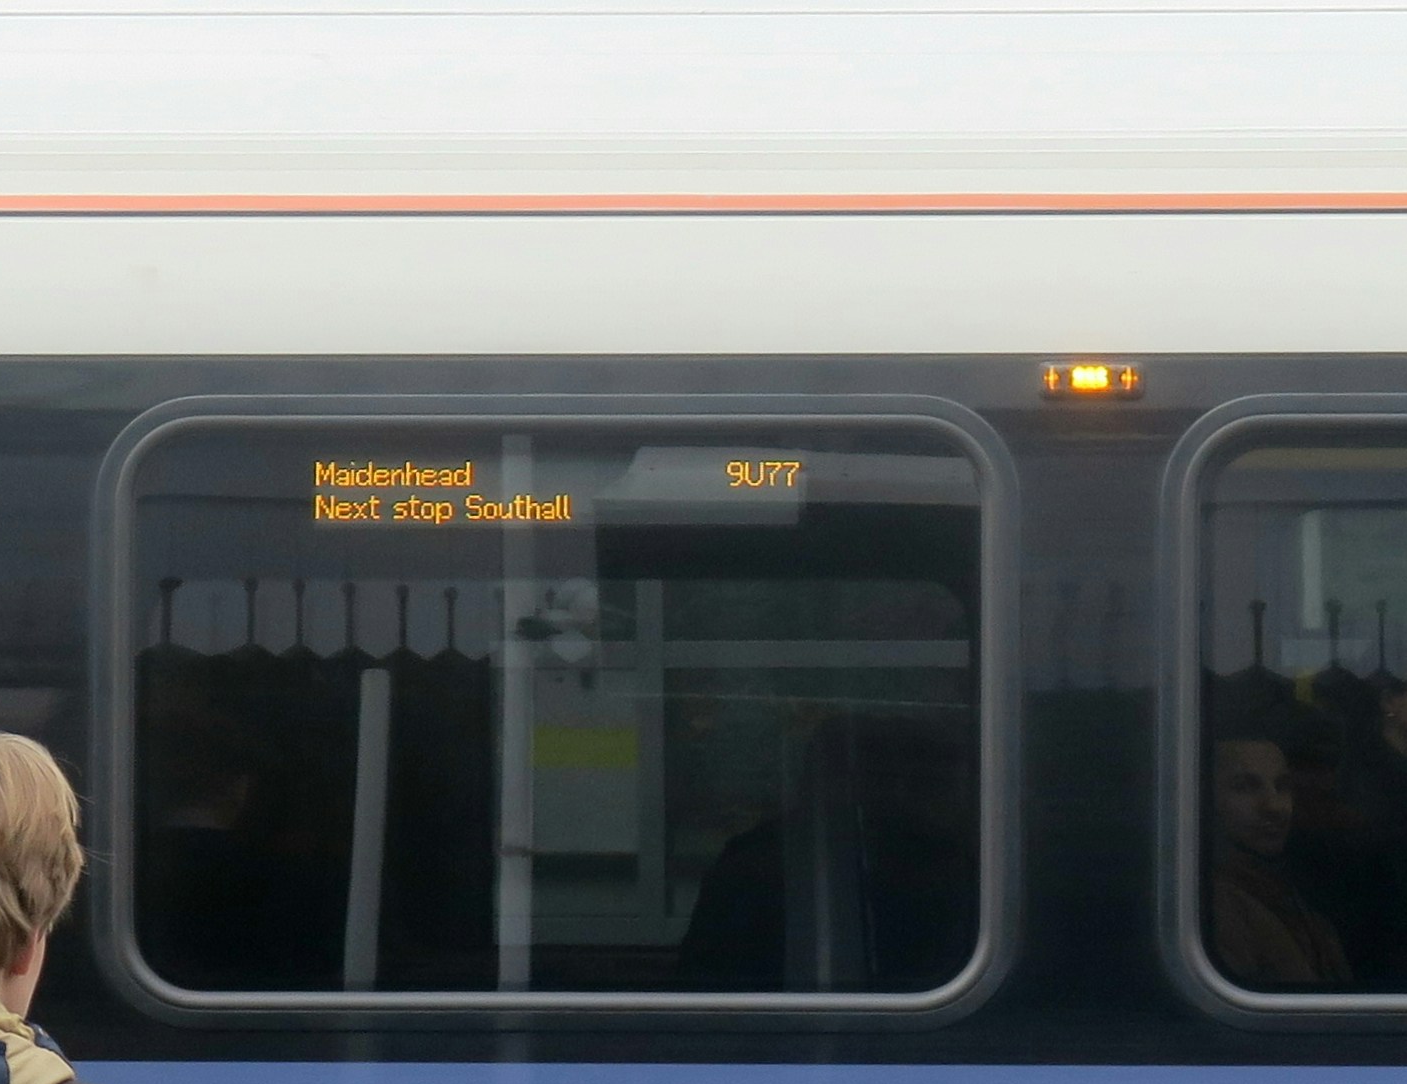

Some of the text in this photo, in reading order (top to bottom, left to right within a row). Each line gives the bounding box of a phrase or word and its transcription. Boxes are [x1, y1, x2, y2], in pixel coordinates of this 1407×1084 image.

[314, 461, 801, 488] Maidenhead 9U77
[314, 494, 572, 524] Next stop Southall
